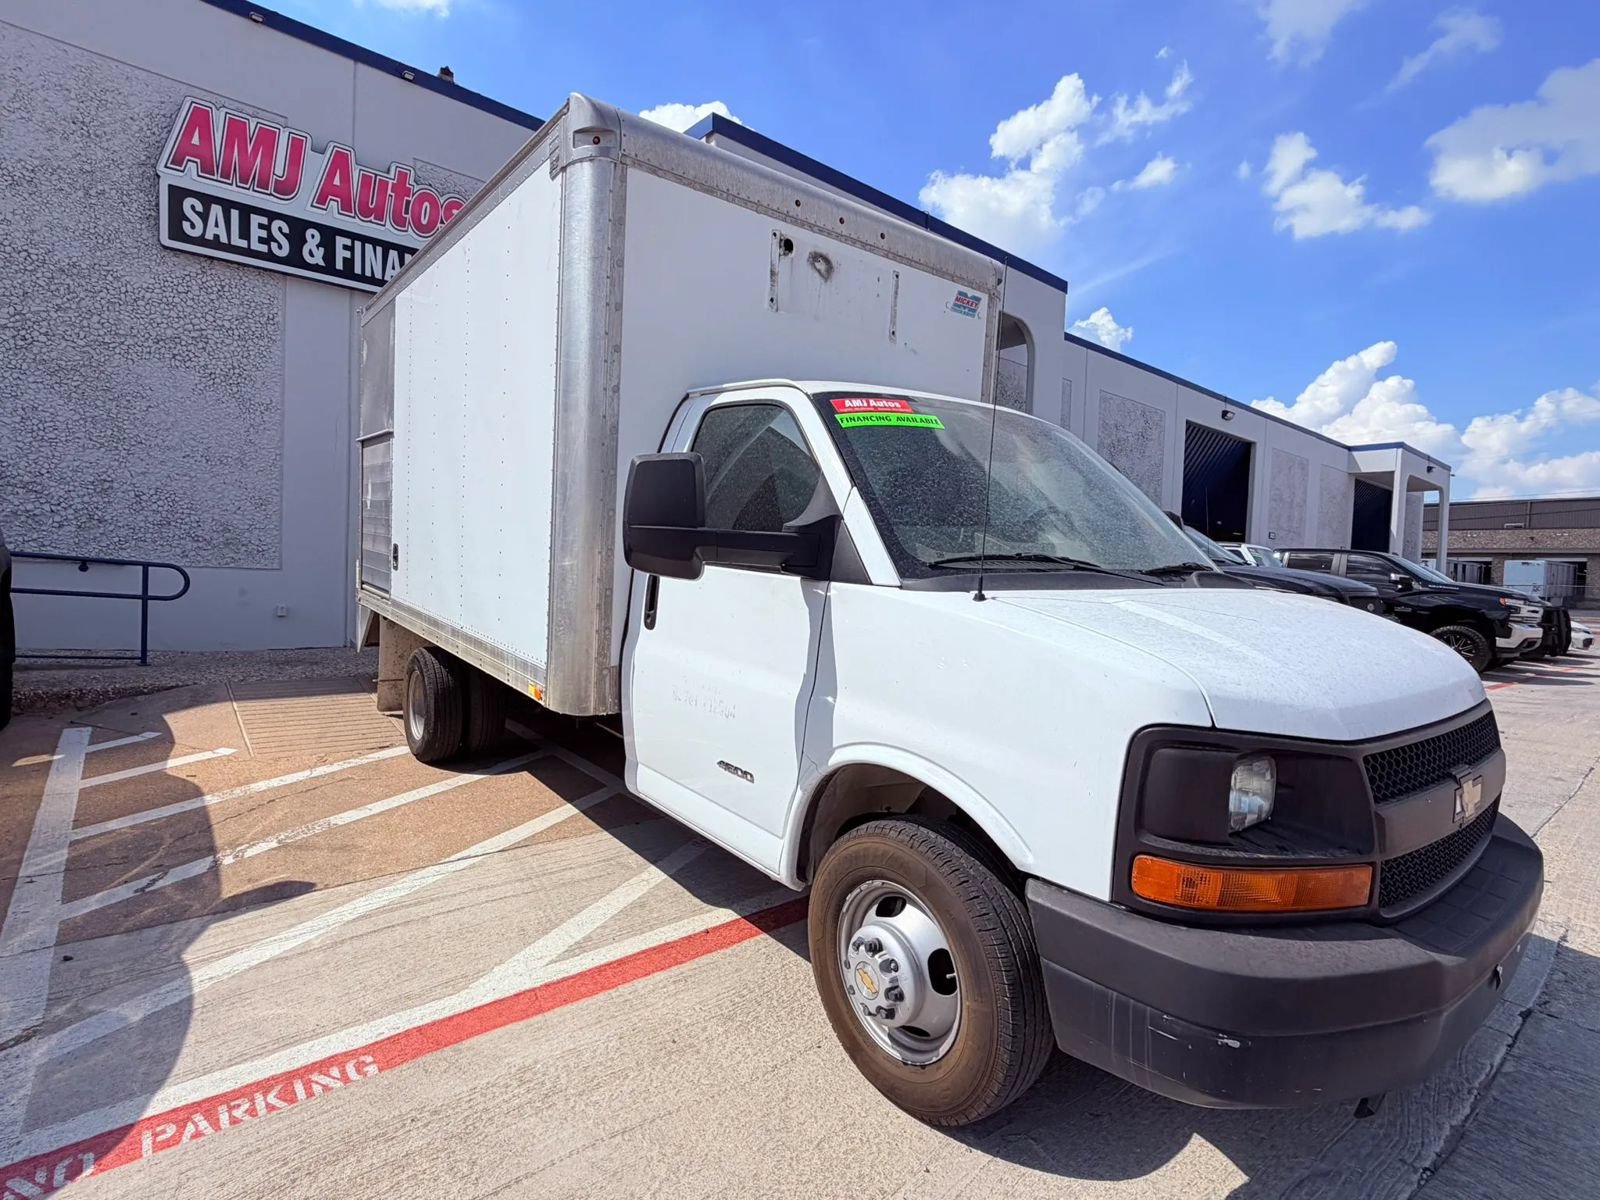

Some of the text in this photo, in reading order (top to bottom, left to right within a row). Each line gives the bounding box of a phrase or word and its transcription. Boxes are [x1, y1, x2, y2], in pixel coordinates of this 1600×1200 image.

[165, 102, 308, 201] AMJ
[182, 197, 412, 280] SALES & FINA
[839, 415, 939, 425] FINANCING AVAILABLE
[844, 398, 902, 408] AMJ Autos
[141, 1055, 379, 1157] PARKING
